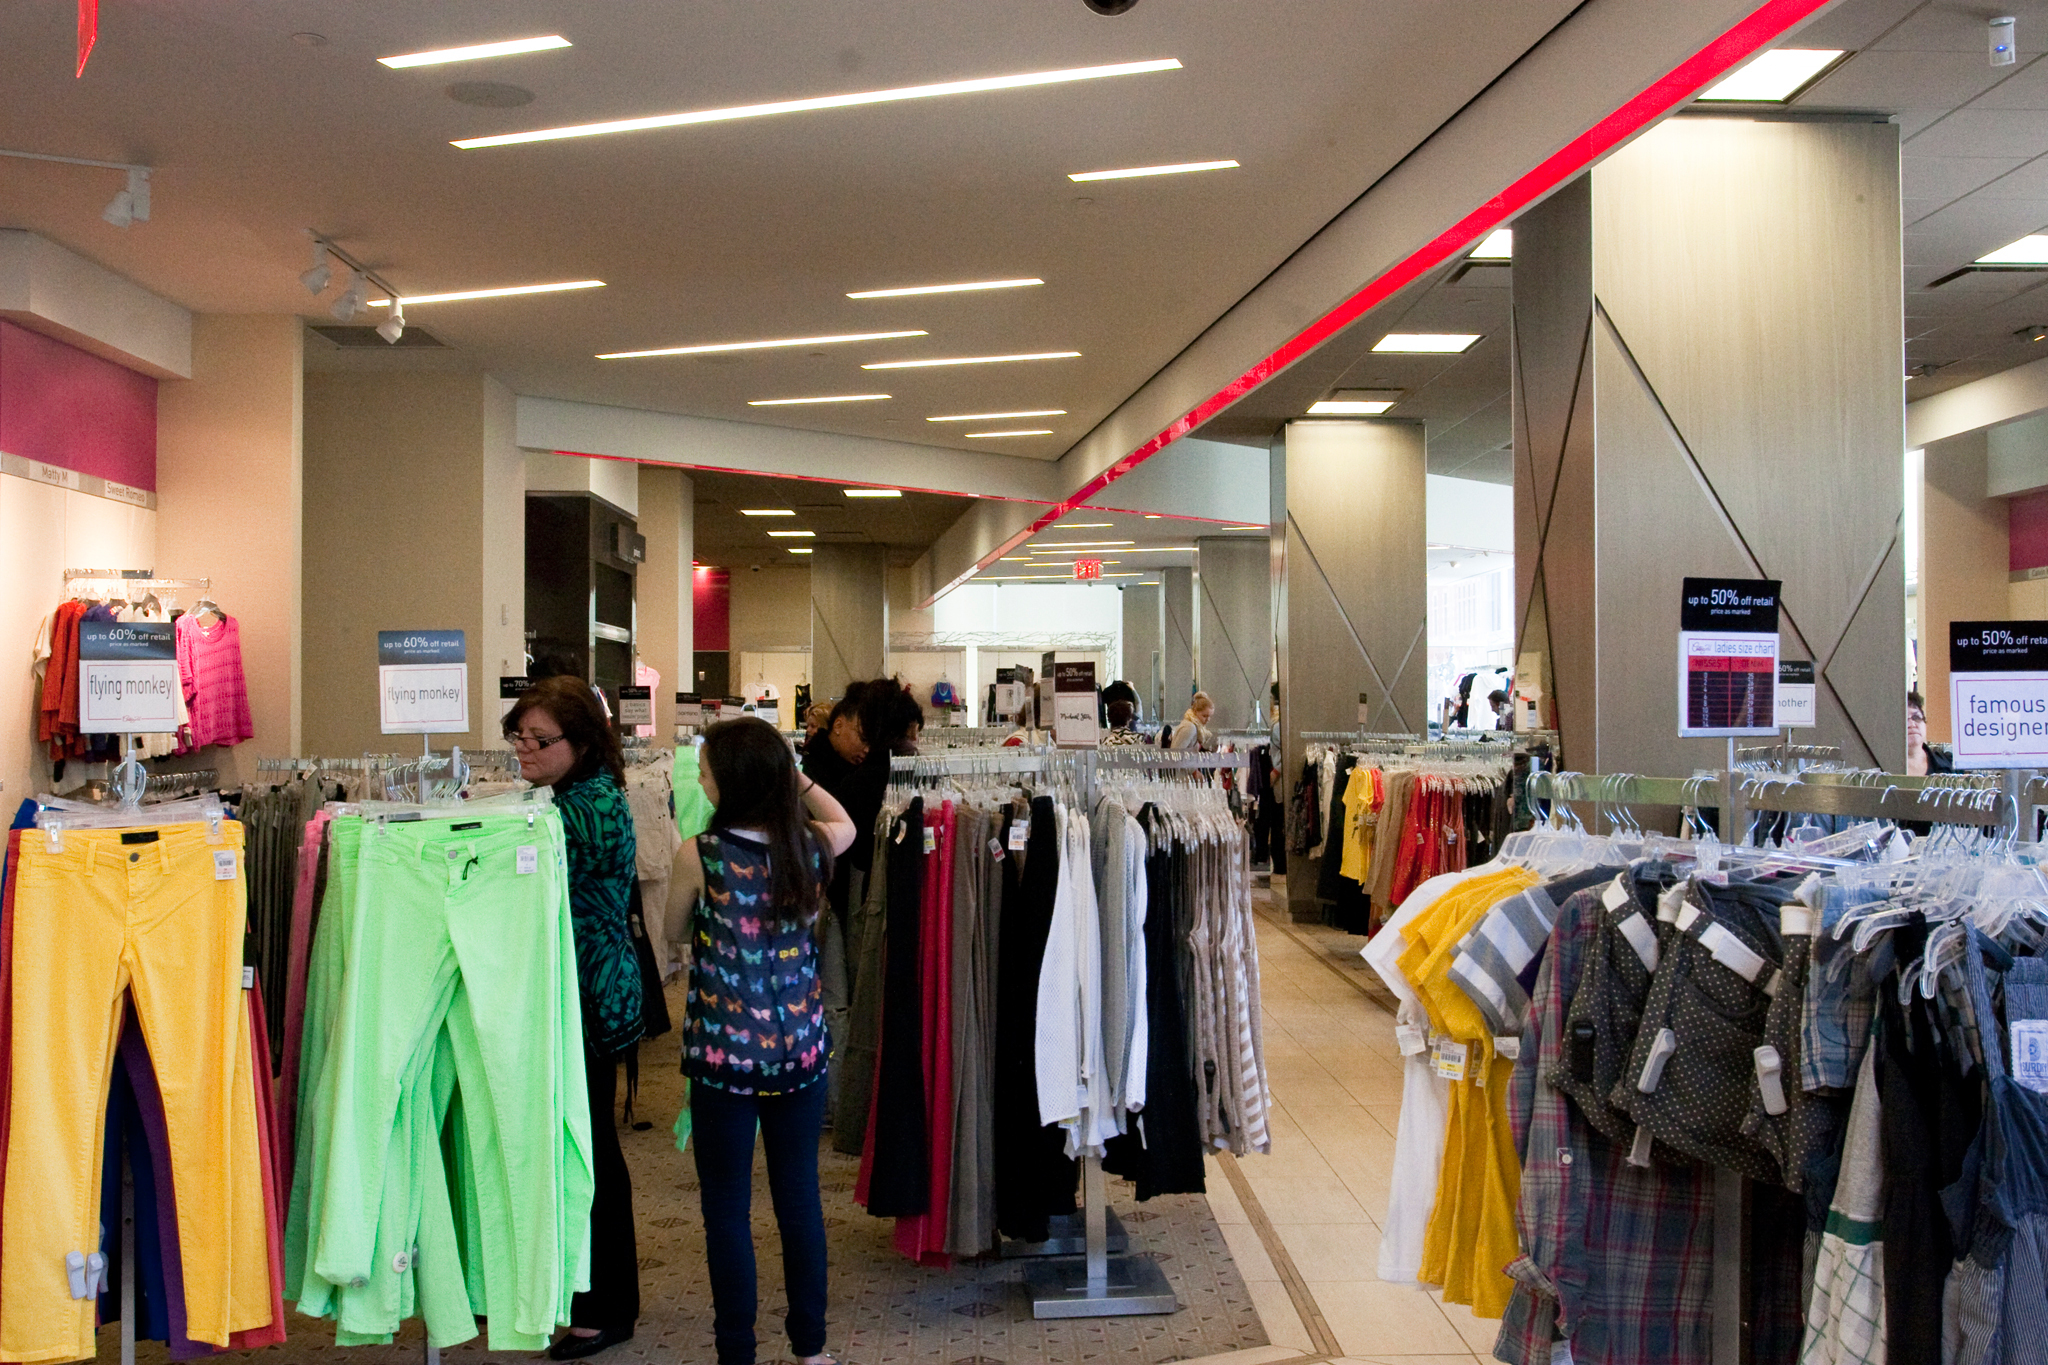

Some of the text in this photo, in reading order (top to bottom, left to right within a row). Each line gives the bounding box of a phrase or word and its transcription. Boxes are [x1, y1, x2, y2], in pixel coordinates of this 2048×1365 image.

[42, 466, 69, 484] Matty M
[107, 482, 145, 502] Sweet Romeo
[1688, 588, 1774, 606] up to 50% off retail
[109, 629, 136, 640] 60%
[403, 636, 428, 648] 60%
[1957, 630, 2048, 648] up to 50% off reta
[1714, 641, 1737, 654] ladies
[1738, 641, 1753, 654] size
[1754, 642, 1774, 654] chart
[1066, 667, 1078, 677] 50%
[90, 674, 172, 700] flying monkey
[387, 685, 460, 704] flying monkey
[1970, 694, 2046, 714] famous
